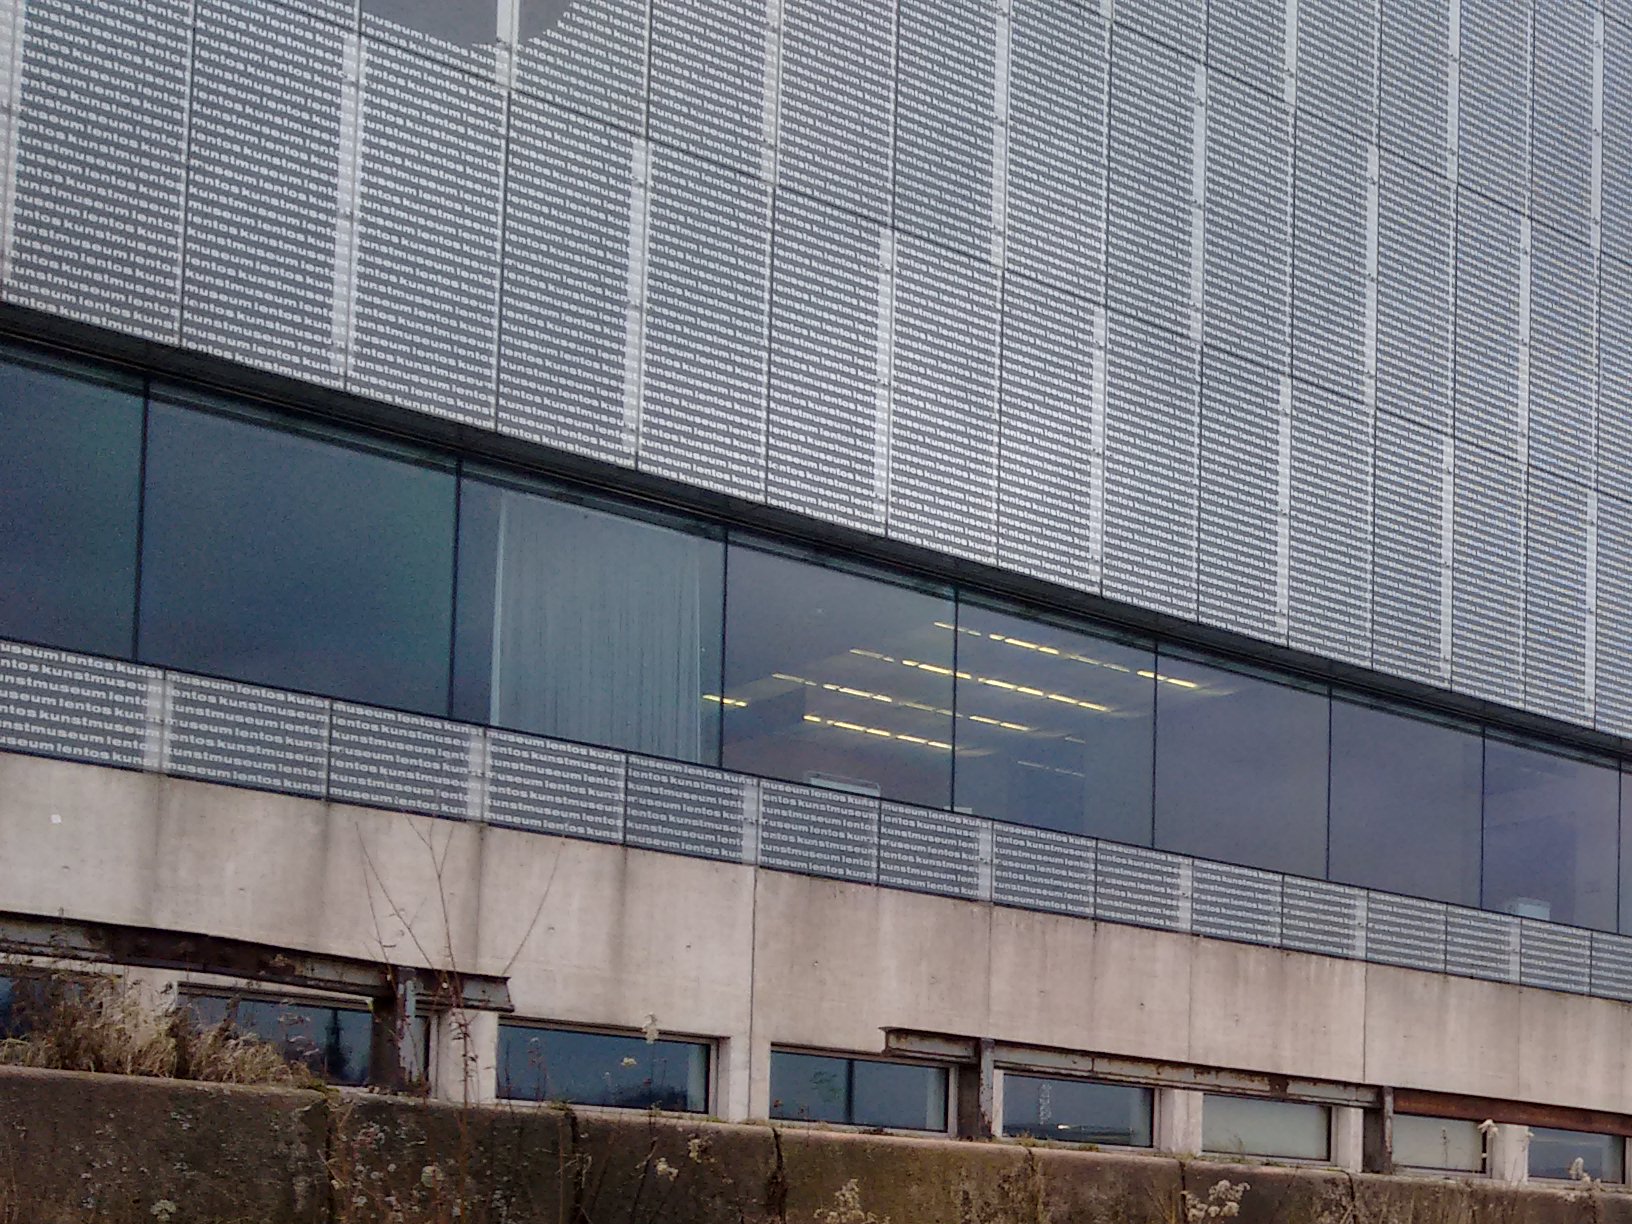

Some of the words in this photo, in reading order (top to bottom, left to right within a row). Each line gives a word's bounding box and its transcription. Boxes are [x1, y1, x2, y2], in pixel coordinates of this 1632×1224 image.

[361, 10, 422, 39] museum
[424, 32, 467, 56] lentos
[360, 35, 461, 80] kunstmuseum
[463, 73, 506, 97] lentos
[192, 101, 303, 146] kunstmuseum
[192, 116, 259, 145] museum
[261, 137, 308, 161] lentos
[191, 129, 241, 153] lentos
[1, 289, 56, 313] lentos
[59, 305, 178, 345] kunstmuseum
[2, 276, 76, 303] museum
[78, 295, 131, 318] lentos
[133, 310, 179, 331] kunst
[684, 289, 769, 324] kunstmuseum
[732, 317, 769, 336] lentos
[184, 326, 251, 351] museum
[253, 343, 301, 364] lentos
[303, 357, 345, 376] kunst
[772, 330, 852, 362] kunstmuseum
[183, 338, 233, 360] lentos
[236, 352, 344, 390] kunstmuseum
[771, 353, 807, 372] lentos
[348, 371, 410, 394] museum
[412, 387, 455, 406] lentos
[457, 399, 496, 417] kunst
[771, 365, 851, 397] kunstmuseum
[771, 378, 819, 399] museum
[821, 393, 855, 410] lentos
[348, 383, 393, 403] lentos
[396, 396, 495, 430] kunstmuseum
[499, 412, 556, 434] museum
[558, 427, 598, 445] lentos
[600, 438, 635, 455] kunst
[499, 424, 541, 442] lentos
[543, 436, 635, 468] kunstmuseum
[638, 450, 691, 470] museum
[692, 464, 730, 481] lentos
[731, 474, 764, 490] kunst
[638, 461, 677, 479] lentos
[679, 472, 764, 502] kunstmuseum
[767, 485, 816, 504] museum
[817, 498, 852, 514] lentos
[854, 508, 884, 523] kunst
[767, 496, 803, 513] lentos
[805, 506, 884, 534] kunstmuseum
[887, 518, 932, 536] museum
[933, 530, 965, 545] lentos
[967, 539, 995, 553] kunst
[887, 528, 920, 544] lentos
[922, 538, 995, 564] kunstmuseum
[61, 652, 113, 670] lentos
[59, 697, 112, 715] lentos
[167, 673, 235, 692] museum
[237, 684, 285, 701] lentos
[287, 693, 329, 709] kunst
[167, 686, 217, 704] lentos
[219, 696, 329, 723] kunstmuseum
[166, 701, 278, 729] kunstmuseum
[280, 721, 328, 737] lentos
[333, 716, 380, 732] lentos
[334, 703, 397, 721] museum
[398, 714, 443, 730] lentos
[57, 742, 110, 760] lentos
[165, 730, 215, 747] lentos
[218, 739, 327, 765] kunstmuseum
[235, 727, 283, 744] lentos
[286, 736, 328, 751] kunst
[333, 730, 437, 756] kunstmuseum
[487, 731, 545, 748] museum
[546, 741, 587, 756] lentos
[589, 748, 625, 762] kunst
[164, 745, 277, 771] kunstmuseum
[279, 763, 327, 779] lentos
[332, 745, 395, 763] museum
[397, 755, 442, 771] lentos
[332, 758, 378, 774] lentos
[487, 743, 529, 759] lentos
[532, 751, 624, 775] kunstmuseum
[487, 757, 581, 781] kunstmuseum
[583, 774, 624, 788] lentos
[628, 757, 682, 773] museum
[684, 766, 722, 780] lentos
[164, 761, 232, 779] museum
[234, 771, 282, 787] lentos
[284, 779, 326, 794] kunst
[331, 772, 436, 797] kunstmuseum
[545, 780, 586, 795] lentos
[588, 788, 623, 801] kunst
[628, 769, 668, 783] lentos
[331, 787, 394, 804] museum
[396, 796, 440, 812] lentos
[486, 784, 528, 799] lentos
[530, 791, 623, 814] kunstmuseum
[627, 781, 717, 804] kunstmuseum
[485, 797, 580, 820] kunstmuseum
[582, 813, 623, 827] lentos
[485, 812, 542, 828] museum
[544, 820, 584, 834] lentos
[586, 827, 622, 840] kunst
[627, 807, 666, 821] lentos
[682, 804, 721, 818] lentos
[626, 820, 715, 842] kunstmuseum
[626, 834, 680, 849] museum
[681, 842, 719, 855] lentos
